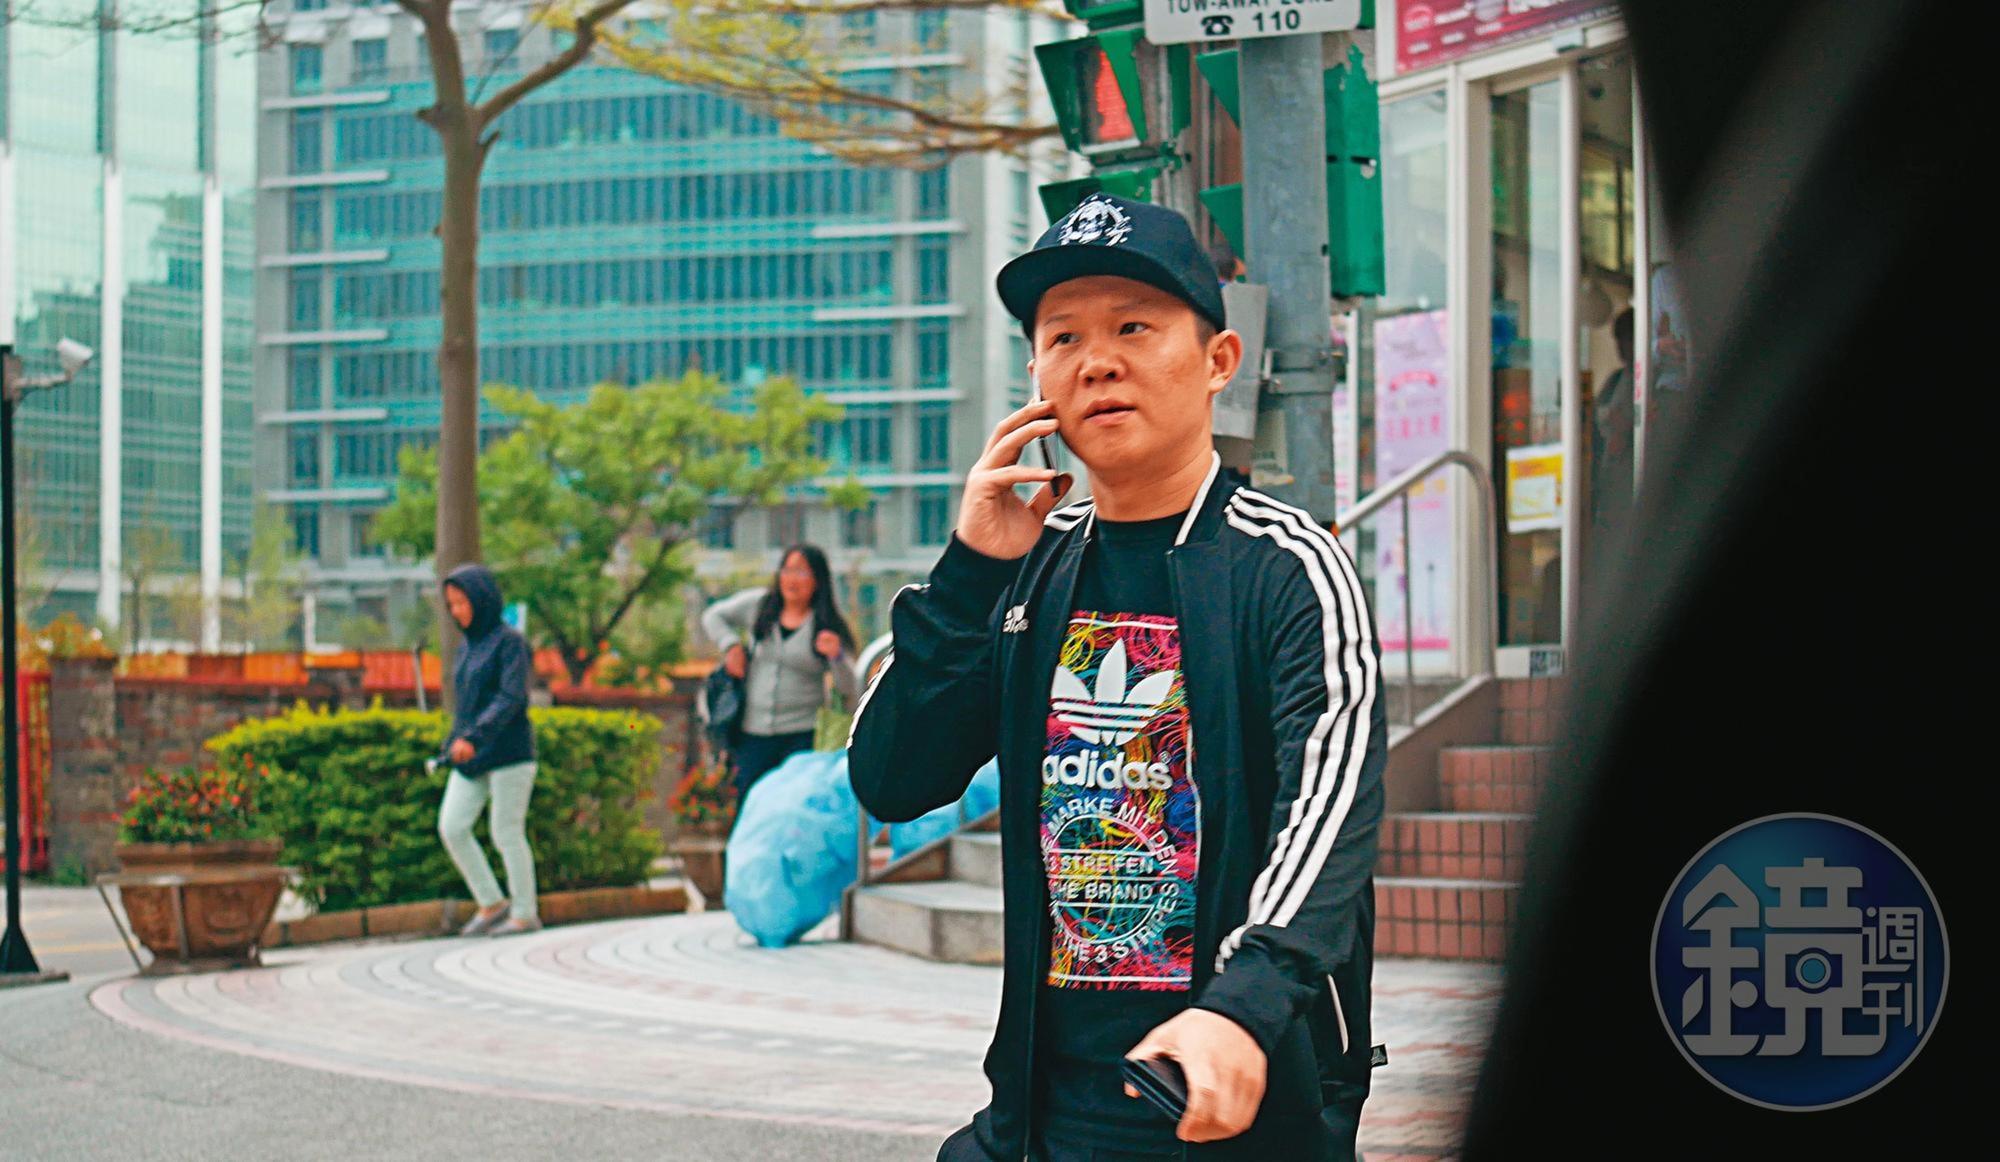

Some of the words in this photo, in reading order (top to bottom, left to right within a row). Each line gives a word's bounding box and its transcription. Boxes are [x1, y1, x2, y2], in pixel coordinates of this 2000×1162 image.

[1252, 9, 1300, 31] 110
[1047, 797, 1115, 836] MARKE
[1116, 801, 1157, 832] MIT
[1148, 829, 1180, 875] DEN
[1060, 853, 1154, 874] STREIFEN
[1084, 882, 1154, 900] BRAND
[1093, 944, 1109, 963] 3
[1112, 883, 1180, 959] STRIPES
